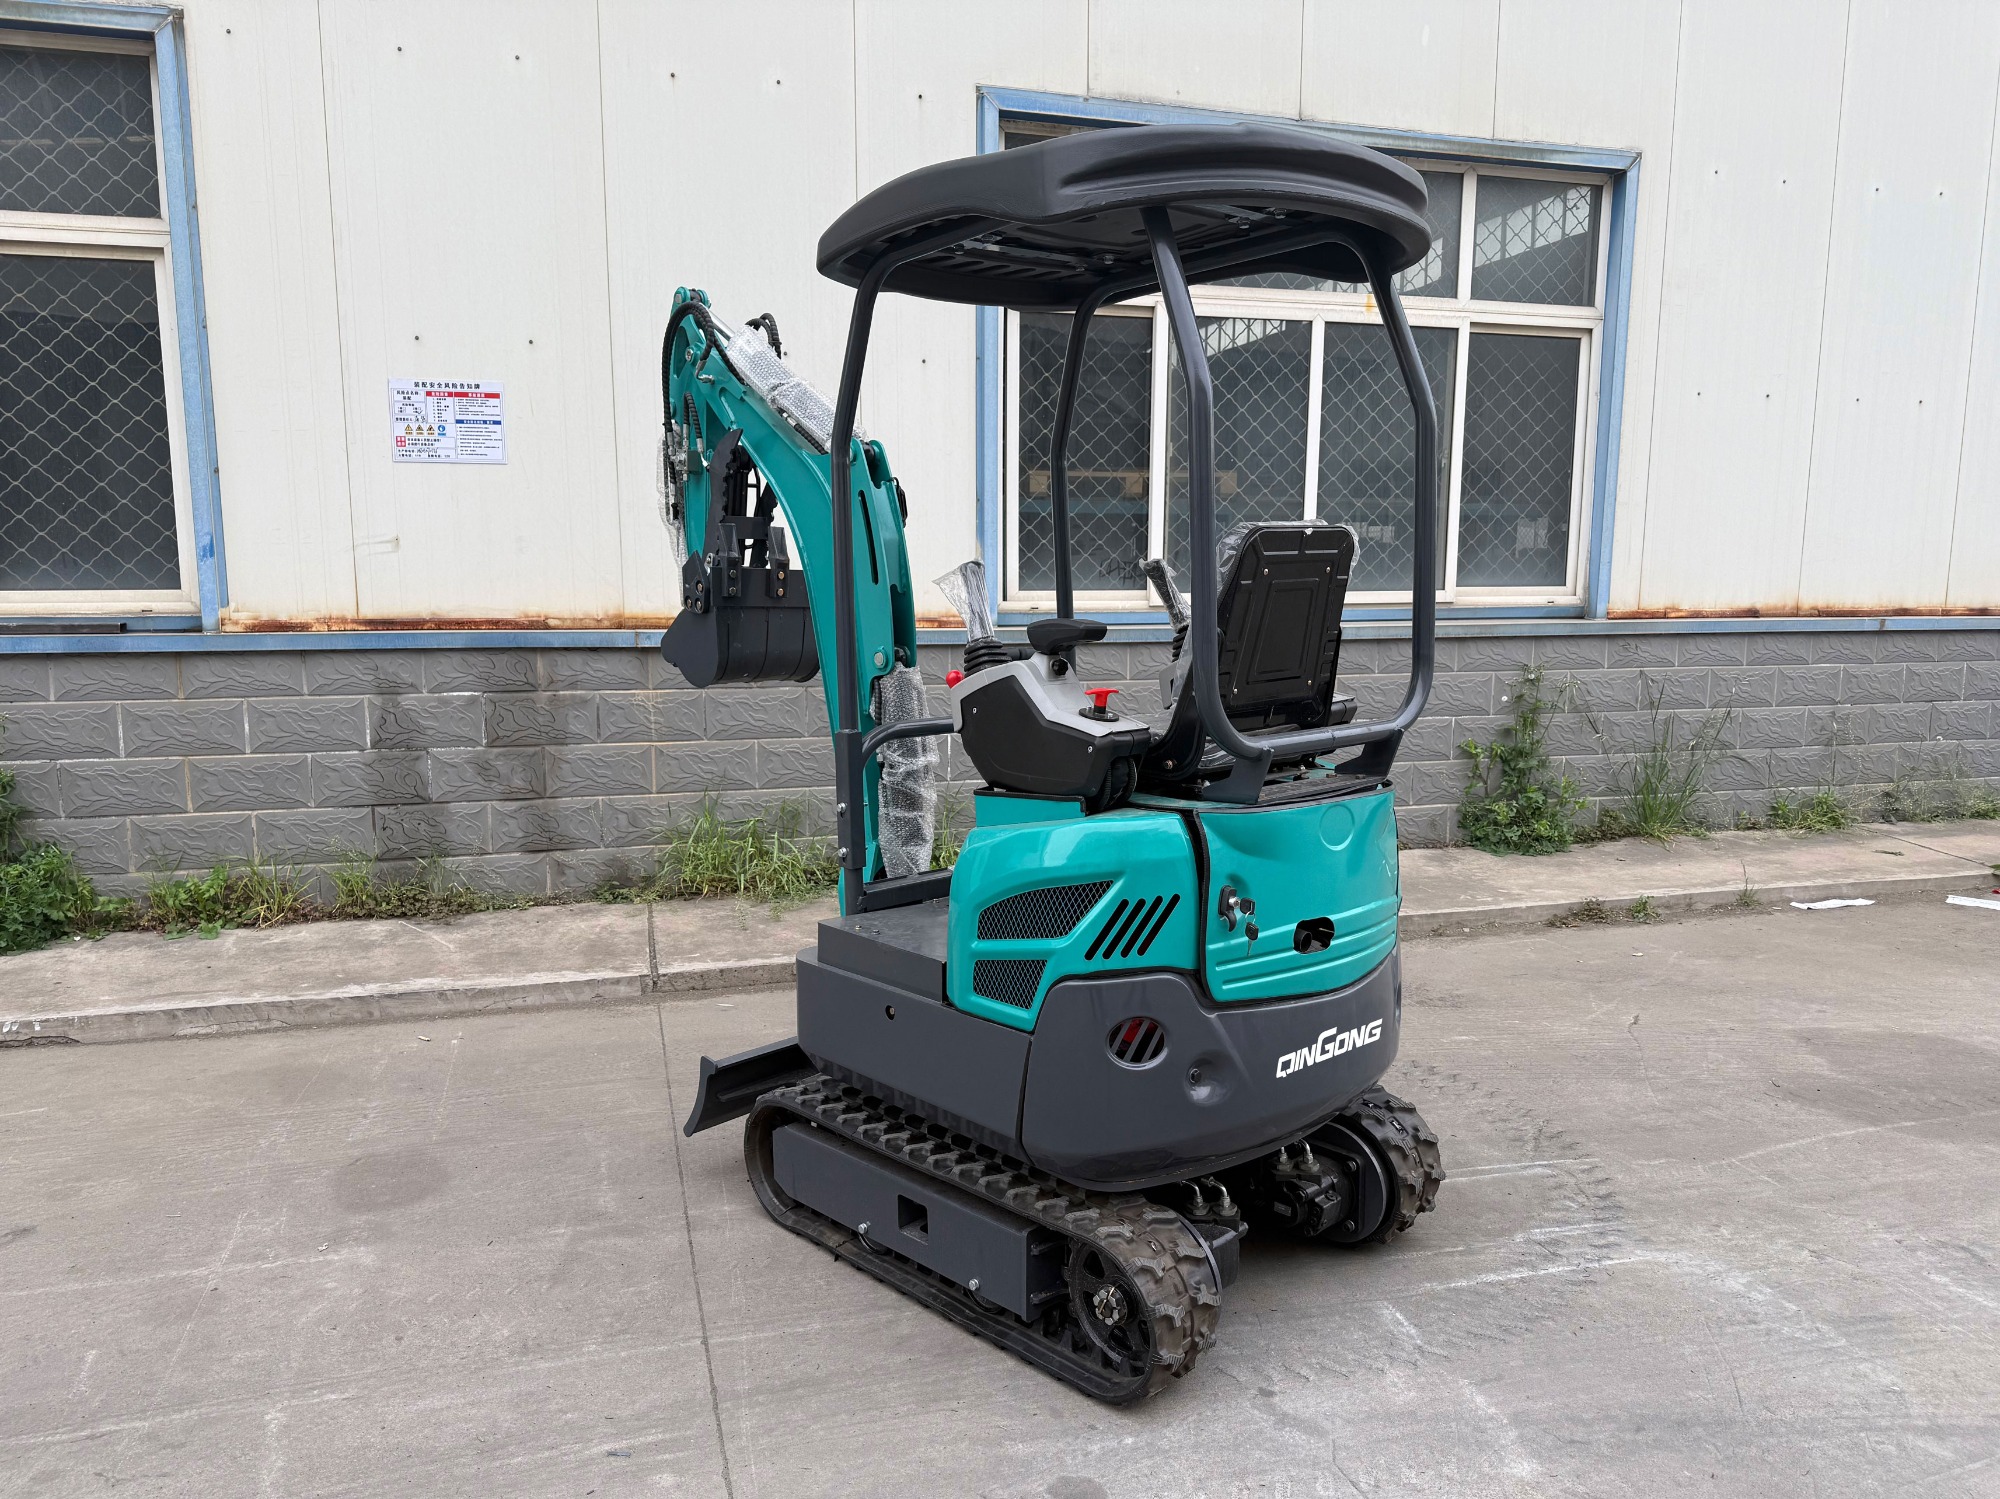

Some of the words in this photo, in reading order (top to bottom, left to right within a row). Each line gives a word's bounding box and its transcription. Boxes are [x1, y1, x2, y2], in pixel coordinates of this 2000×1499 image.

[414, 381, 481, 390] 装配安全风险告知牌
[1276, 1018, 1383, 1079] QINGONG
